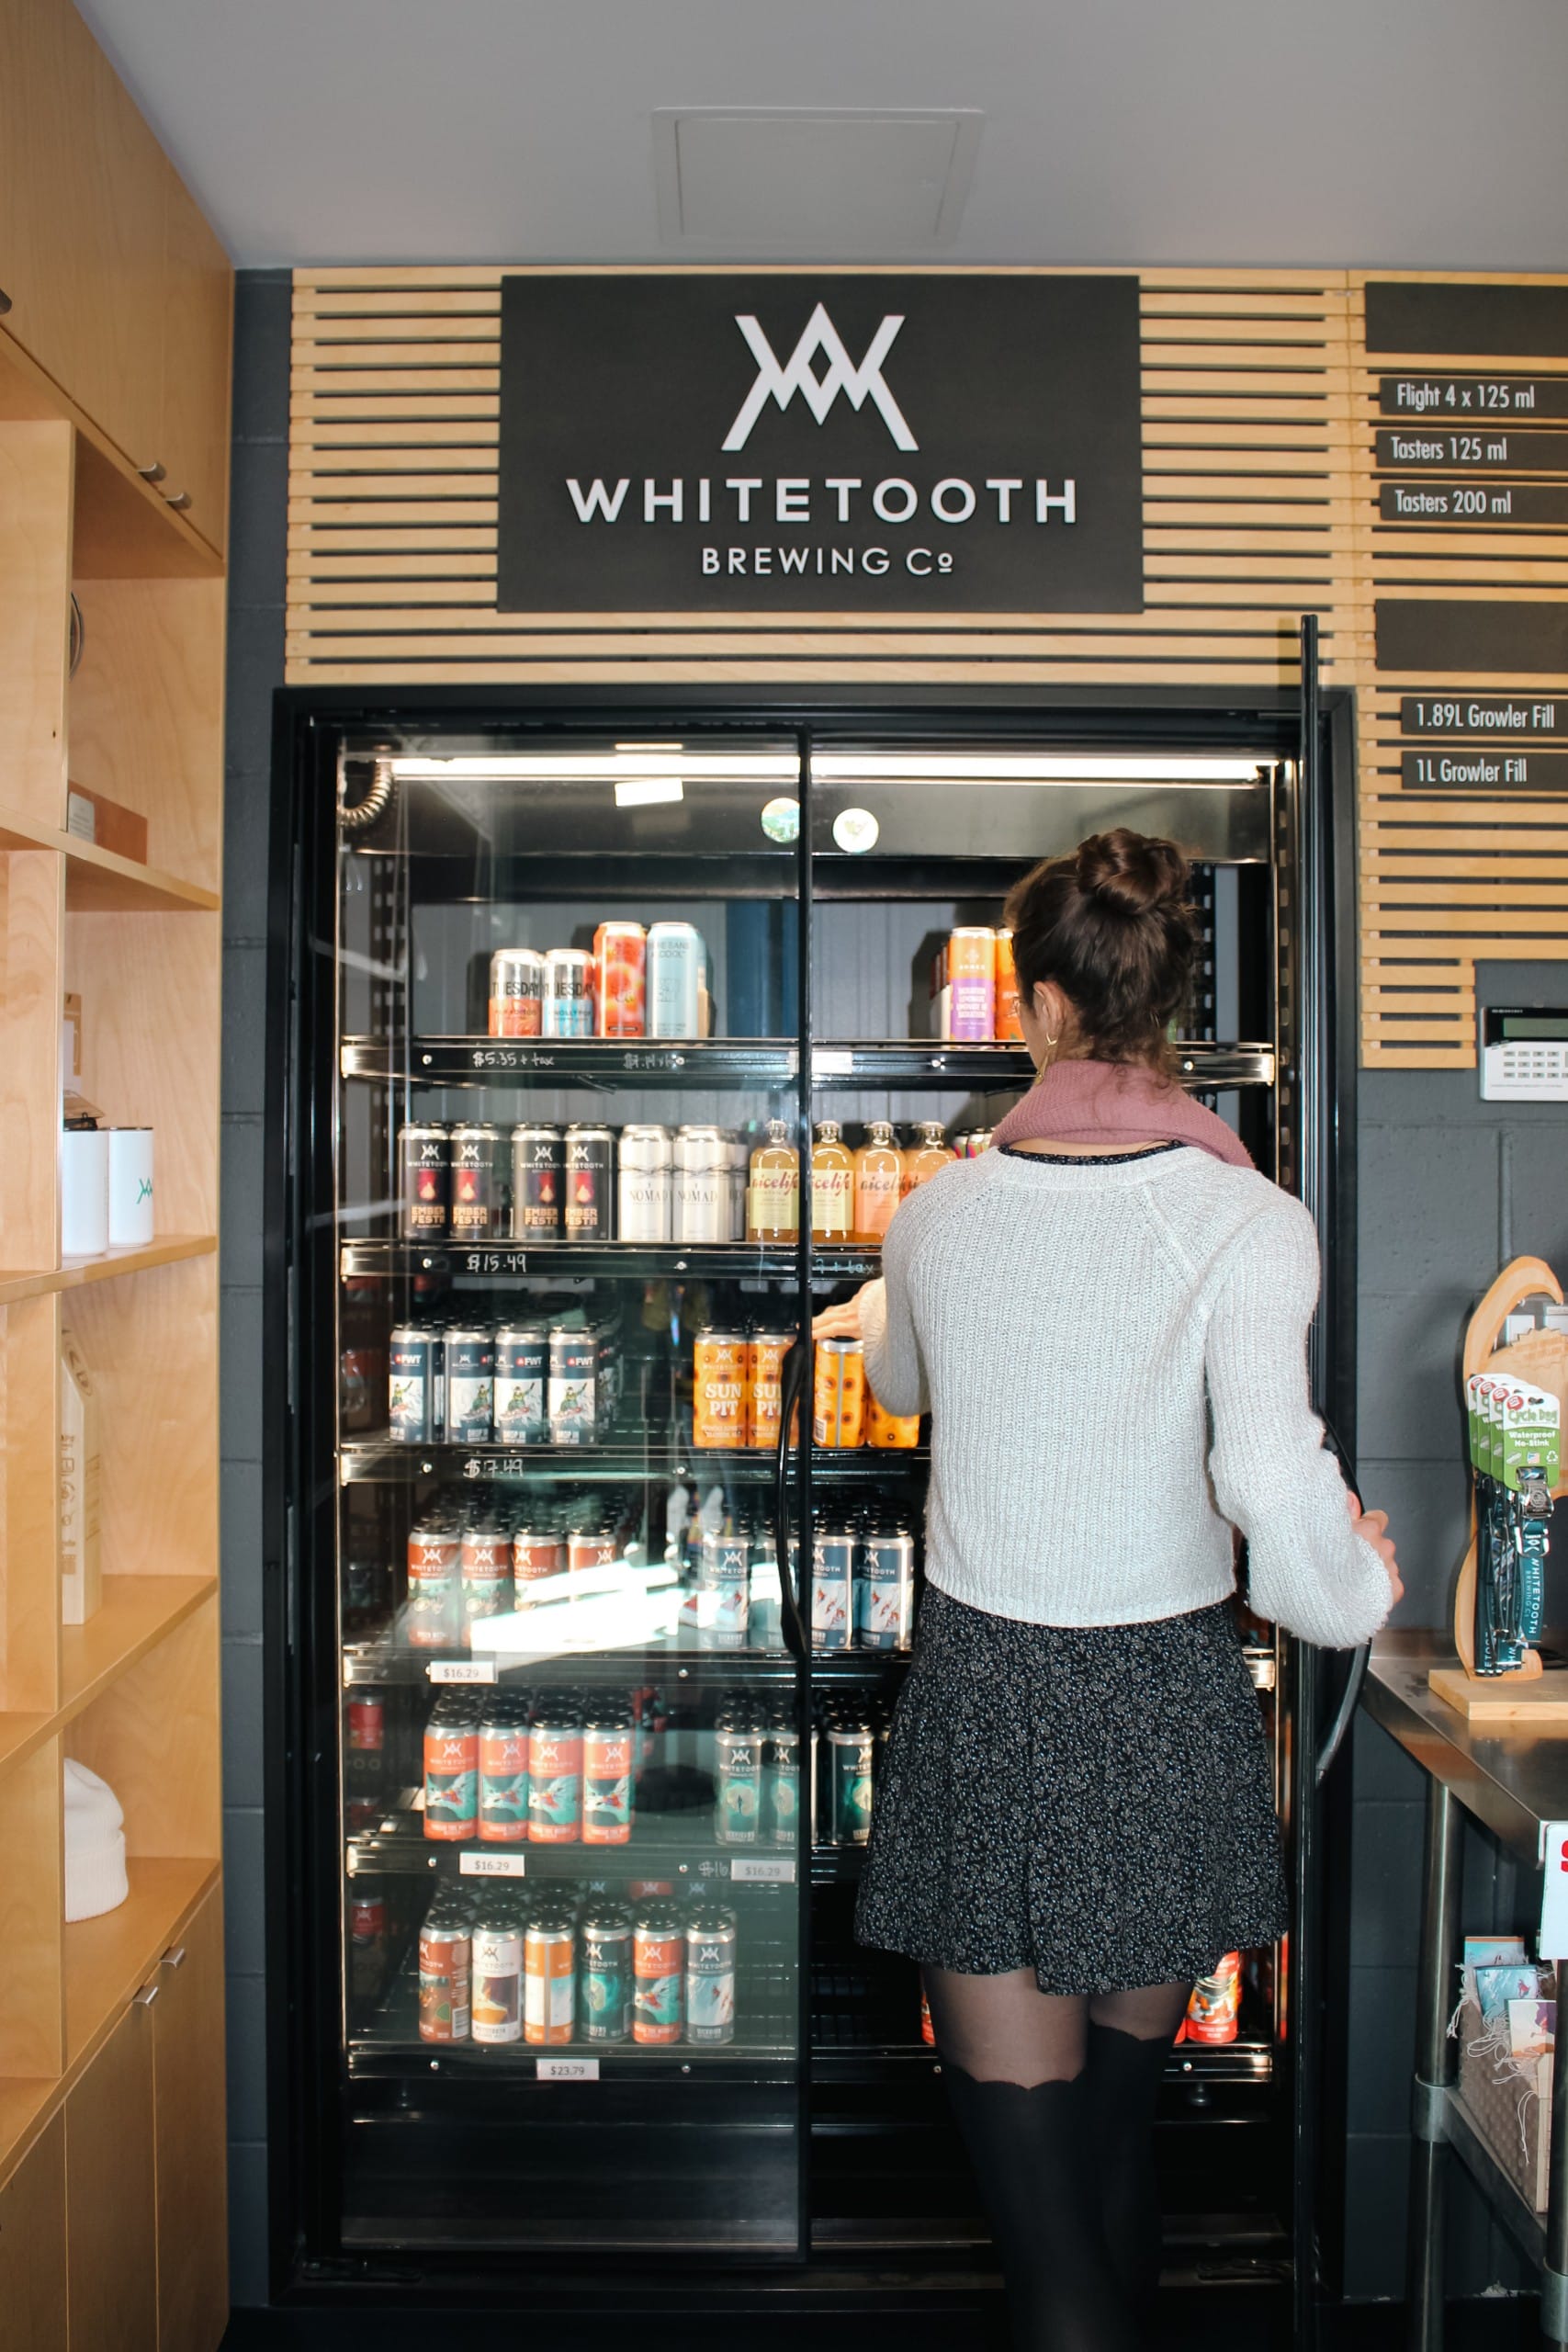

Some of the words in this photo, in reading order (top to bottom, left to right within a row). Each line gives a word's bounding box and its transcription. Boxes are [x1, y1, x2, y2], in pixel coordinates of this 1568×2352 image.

[1397, 385, 1440, 413] Flight
[1446, 387, 1456, 407] 4
[1461, 392, 1472, 408] x
[1479, 386, 1511, 408] 125
[1516, 386, 1535, 409] ml
[1392, 436, 1443, 460] Tasters
[1450, 438, 1483, 460] 125
[1487, 438, 1507, 461] ml
[566, 478, 1077, 524] WHITETOOTH
[1394, 490, 1447, 513] Tasters
[1453, 491, 1486, 514] 200
[1492, 492, 1512, 514] ml
[702, 547, 890, 576] BREWING
[1416, 704, 1464, 727] 1.89L
[1468, 705, 1527, 729] Growler
[1532, 705, 1554, 729] Fill
[1416, 760, 1436, 782] 1L
[1440, 760, 1502, 783] Growler
[1506, 761, 1528, 783] Fill
[472, 1051, 517, 1068] $5.35
[531, 1052, 555, 1067] tax
[467, 1253, 526, 1272] $15.49
[705, 1383, 742, 1398] SUN
[709, 1400, 739, 1417] PIT
[1508, 1431, 1556, 1440] Waterproof
[1529, 1558, 1540, 1634] WHITETOOTH
[444, 1668, 479, 1679] $16.29
[474, 1860, 510, 1871] $16.29
[745, 1865, 781, 1877] $16.29
[550, 2065, 585, 2076] $23.79
